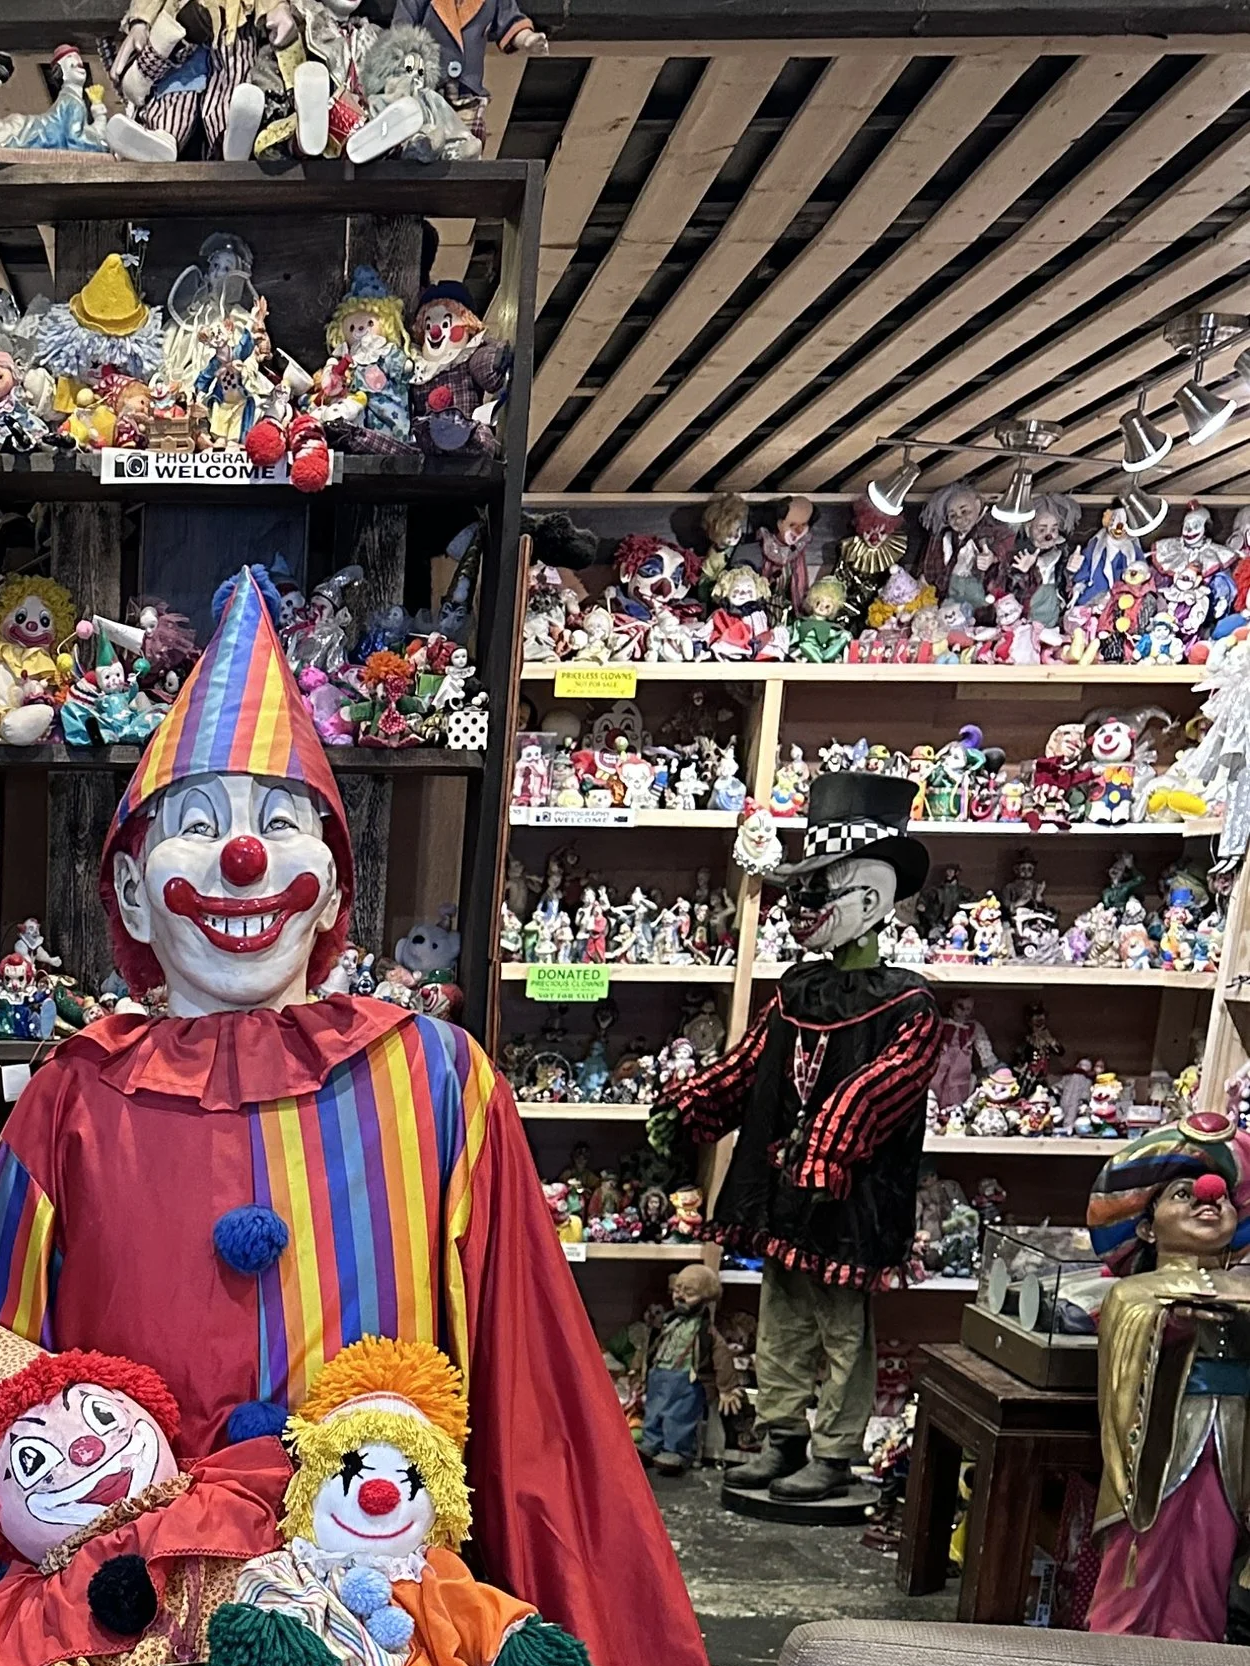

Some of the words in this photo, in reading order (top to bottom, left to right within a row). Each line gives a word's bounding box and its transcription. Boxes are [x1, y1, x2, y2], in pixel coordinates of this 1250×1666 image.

[155, 452, 252, 464] PHOTOGRA
[155, 465, 275, 479] WELCOME
[561, 672, 598, 680] PRICELESS
[600, 672, 633, 681] CLOWNS
[537, 969, 601, 980] DONATED
